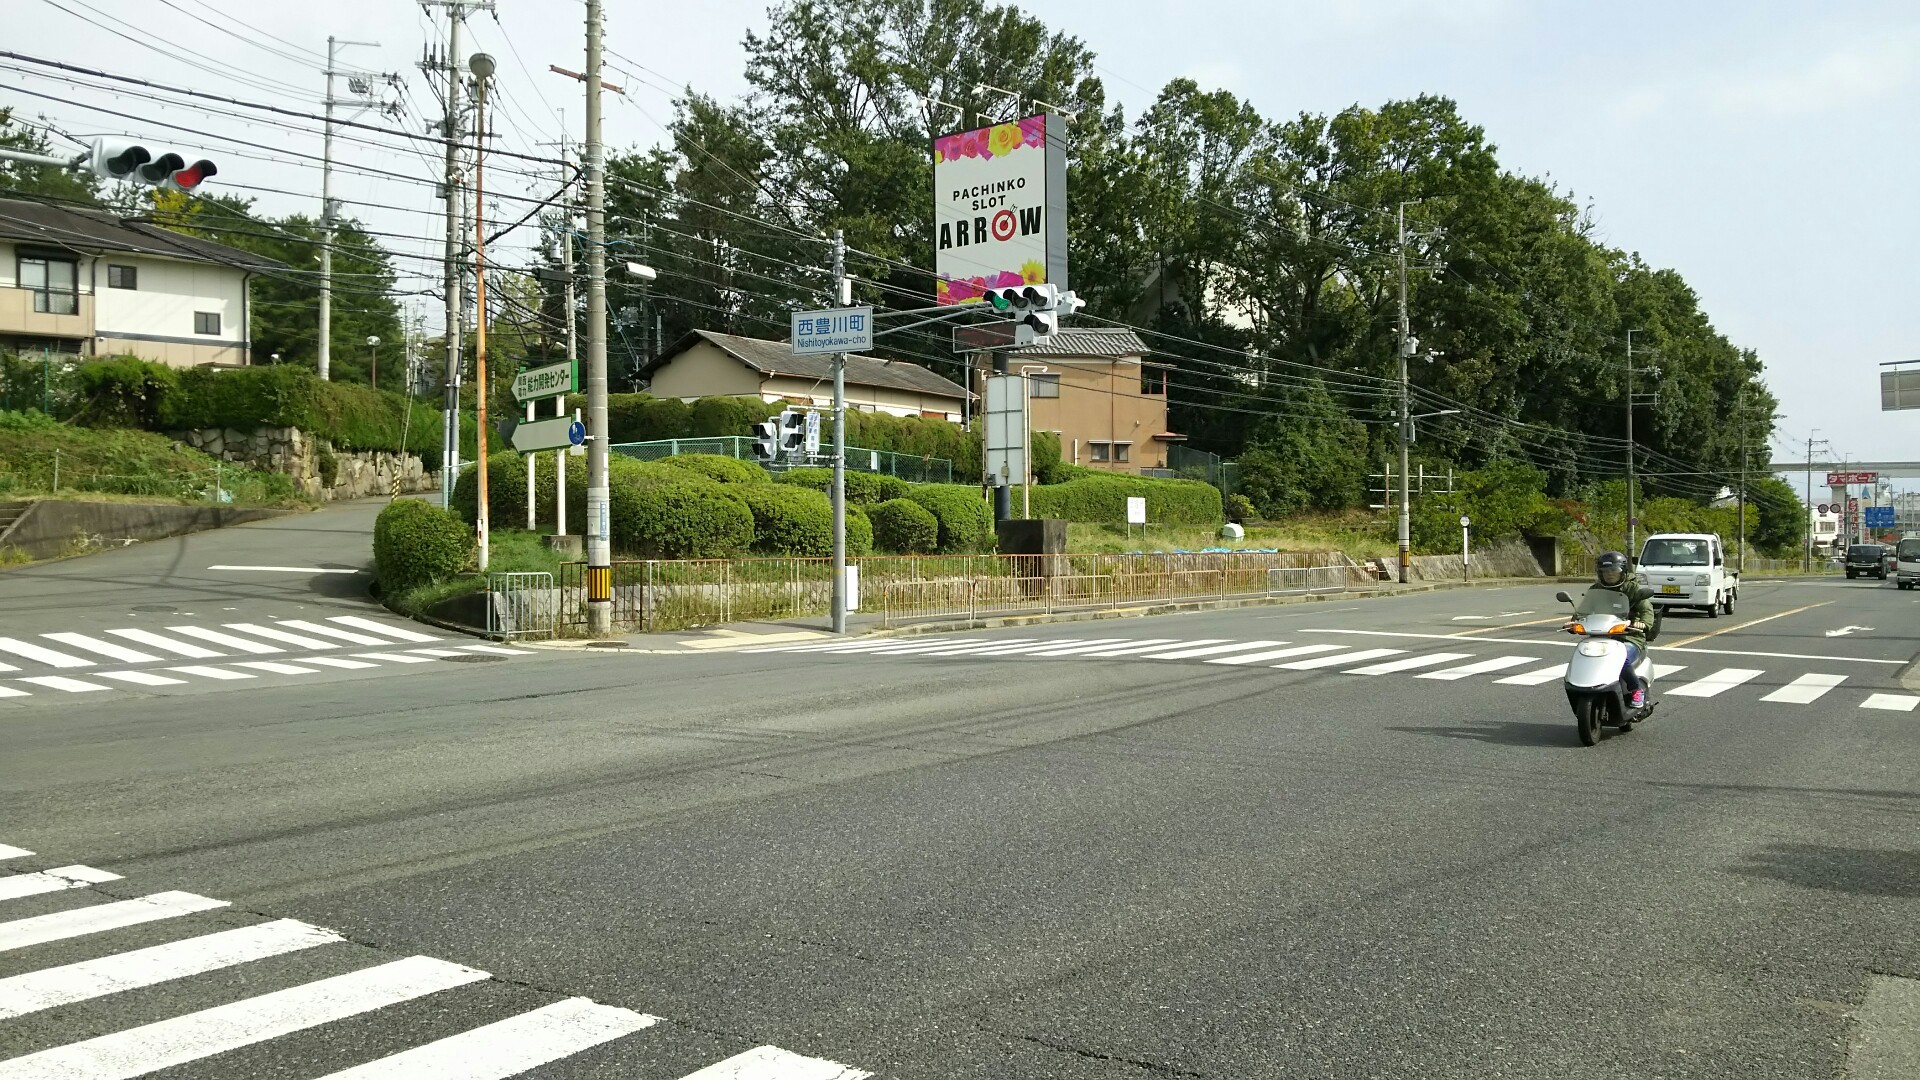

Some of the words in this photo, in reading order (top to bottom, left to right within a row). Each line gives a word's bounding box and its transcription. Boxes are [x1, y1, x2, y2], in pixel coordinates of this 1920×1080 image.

[953, 177, 1026, 201] PACHINKO
[972, 195, 1006, 211] SLOT
[939, 206, 1042, 250] ARROW
[798, 314, 865, 336] 西豊川町
[797, 335, 866, 349] Nishitoyokawa-cho
[527, 369, 570, 393] 能力開発センター
[1828, 474, 1877, 483] タマホーム
